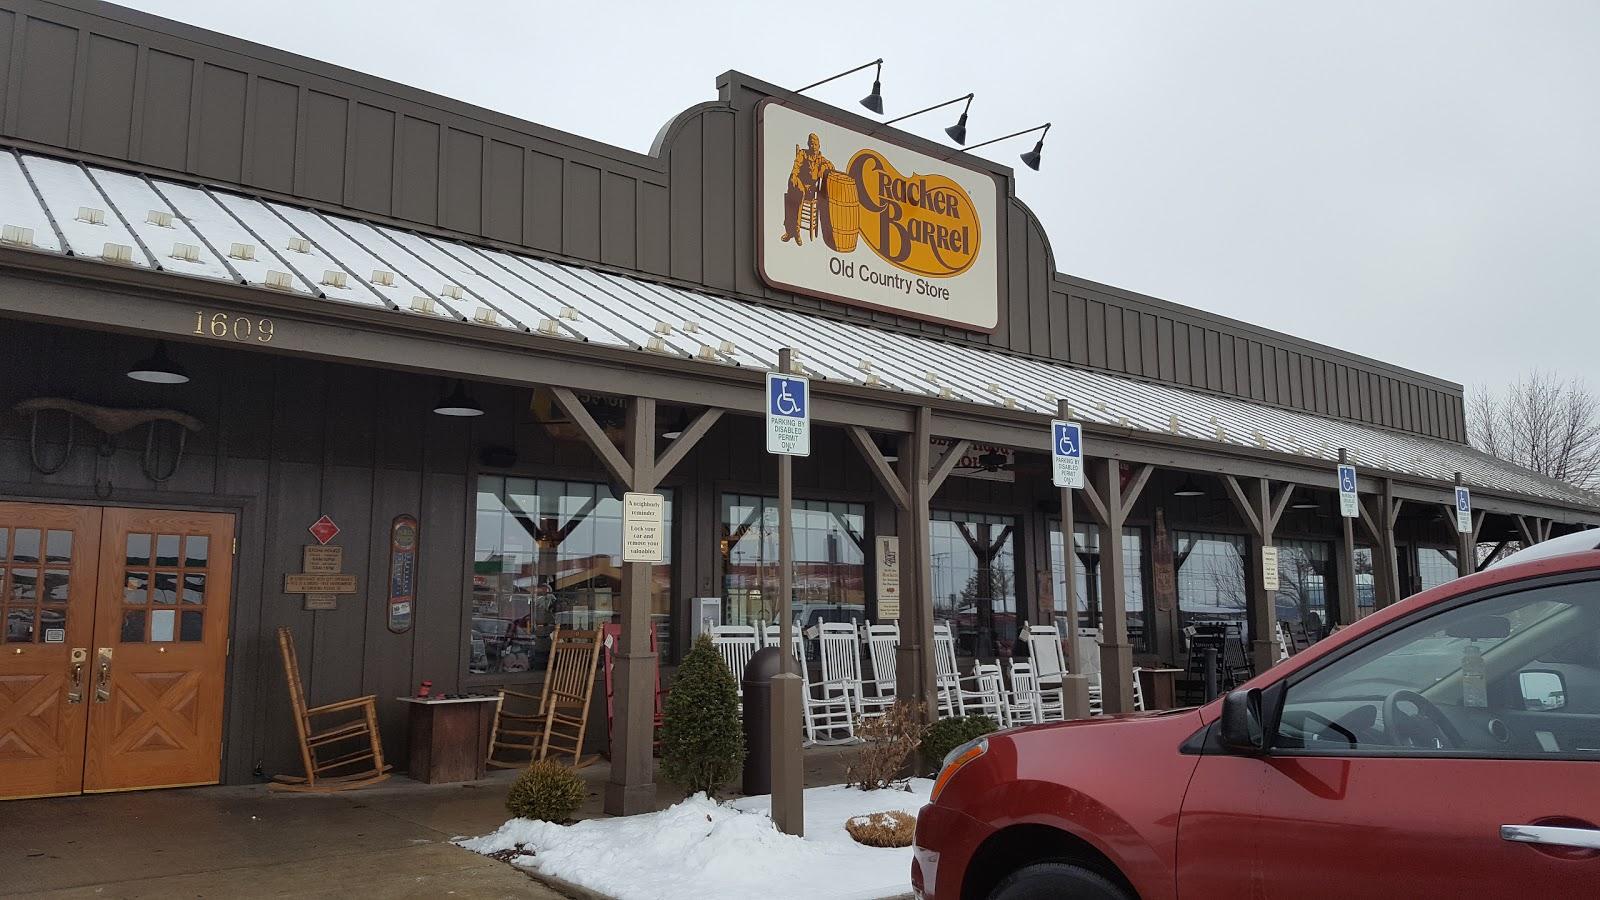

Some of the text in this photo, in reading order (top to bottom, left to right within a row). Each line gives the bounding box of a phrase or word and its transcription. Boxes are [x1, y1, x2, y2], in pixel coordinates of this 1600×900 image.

[849, 153, 961, 219] Cracker
[879, 198, 970, 266] Barrel
[829, 256, 950, 301] Old Country Store
[193, 311, 274, 342] 1609
[771, 417, 796, 426] PARKING
[774, 425, 802, 434] DISABLED
[778, 433, 798, 441] PERMIT
[781, 441, 796, 449] ONLY
